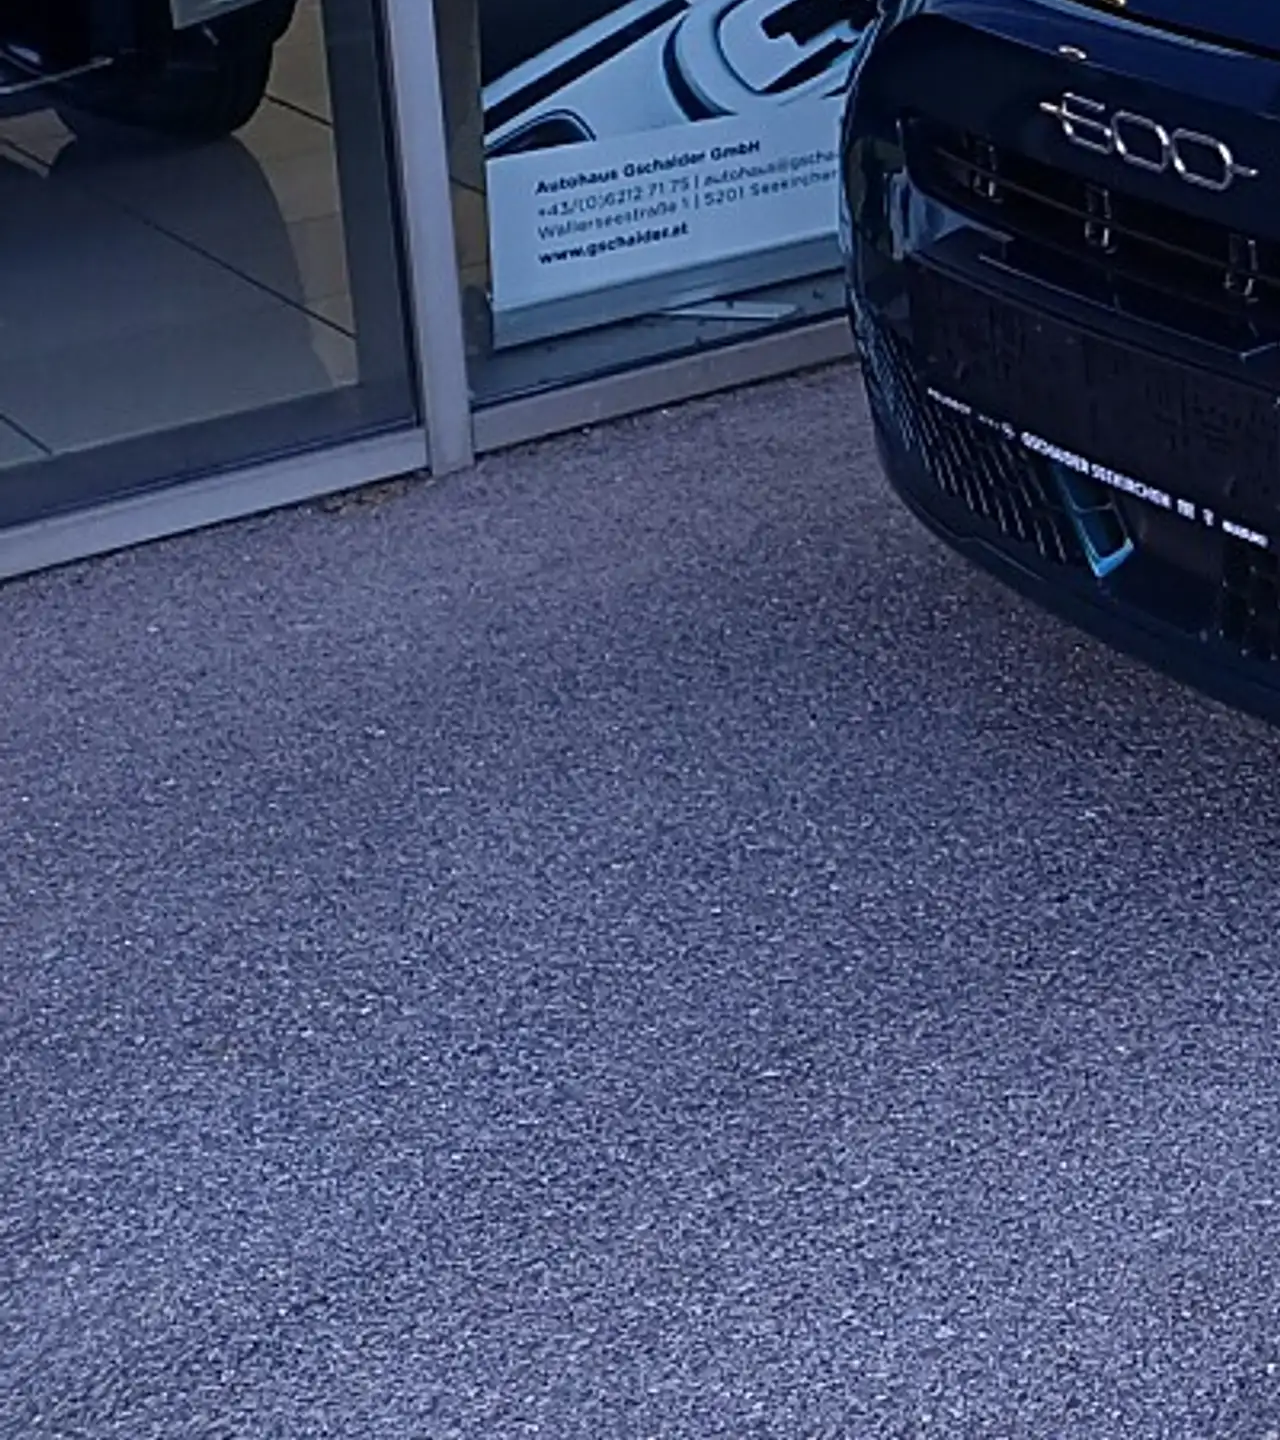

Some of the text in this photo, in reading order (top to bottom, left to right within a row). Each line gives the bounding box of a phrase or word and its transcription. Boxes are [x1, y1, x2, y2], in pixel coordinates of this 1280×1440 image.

[535, 140, 760, 195] Autohaus Gschaider GmbH
[1040, 92, 1258, 190] 600
[704, 186, 744, 207] 5201
